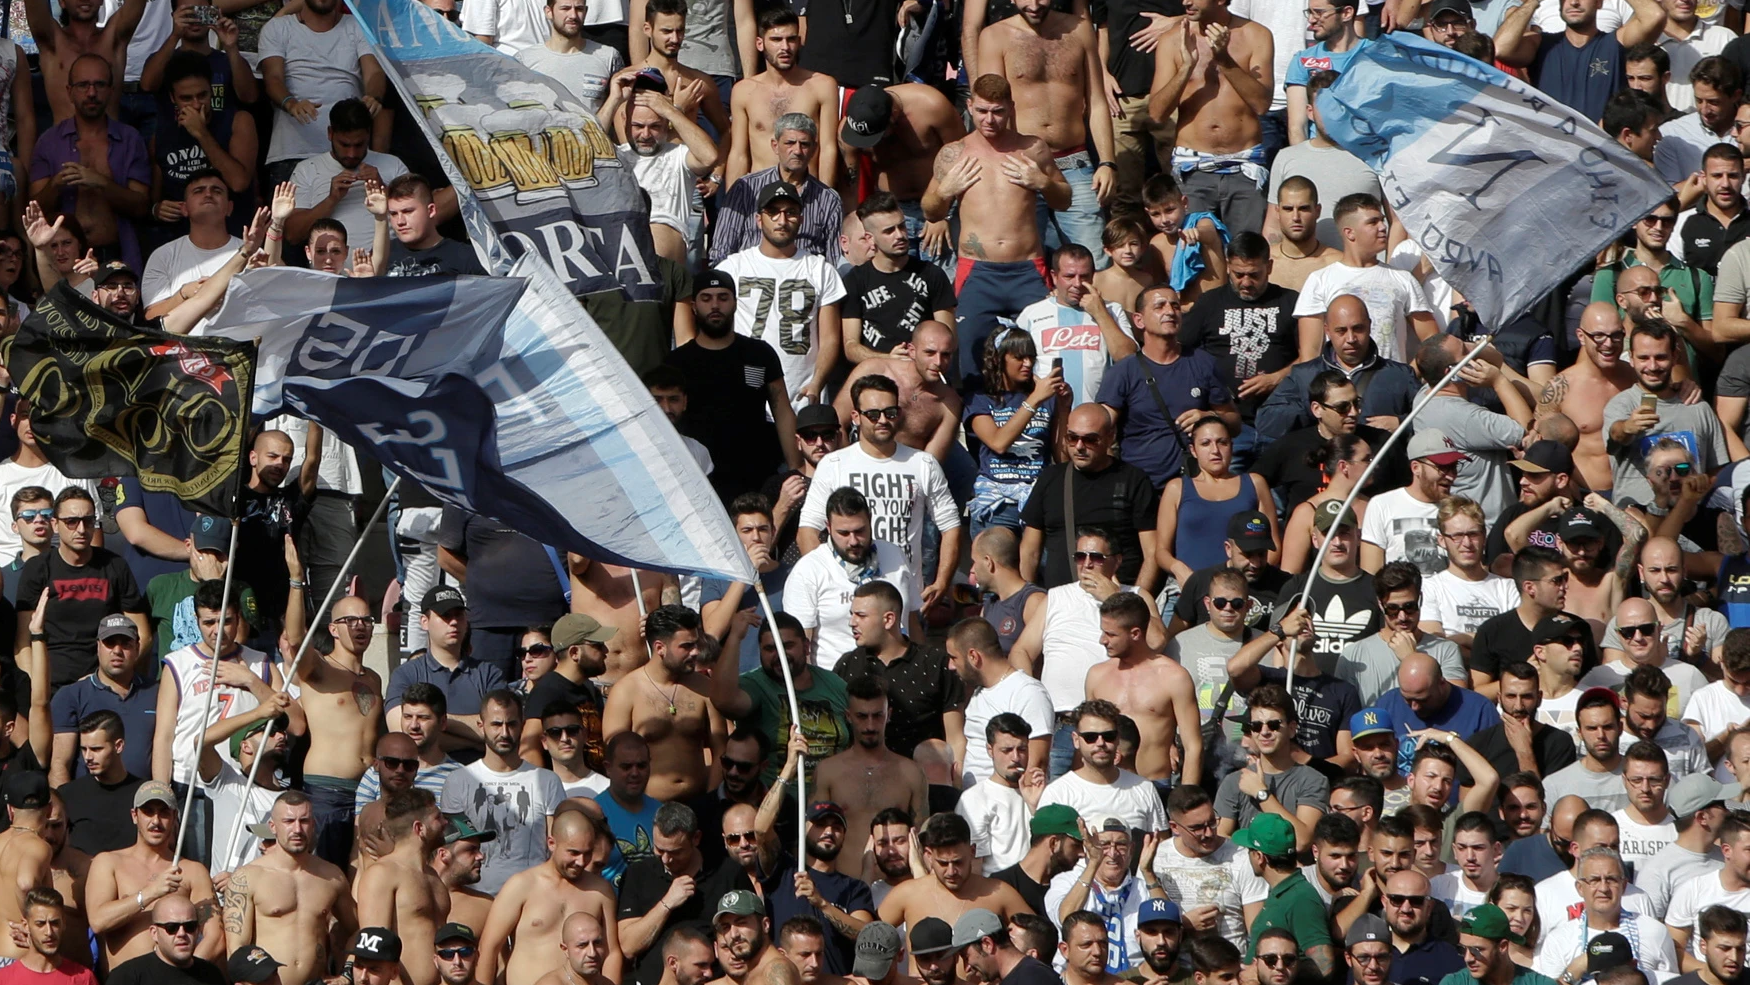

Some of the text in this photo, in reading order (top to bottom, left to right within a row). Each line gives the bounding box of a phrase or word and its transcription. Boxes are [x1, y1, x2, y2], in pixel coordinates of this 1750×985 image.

[861, 285, 892, 310] LIFE
[737, 277, 818, 356] 78
[1218, 306, 1280, 336] JUST
[1043, 326, 1100, 352] Lete
[848, 473, 915, 499] FIGHT
[218, 693, 235, 721] 7
[1364, 711, 1378, 725] NY
[1152, 899, 1166, 912] NY
[356, 932, 383, 953] M
